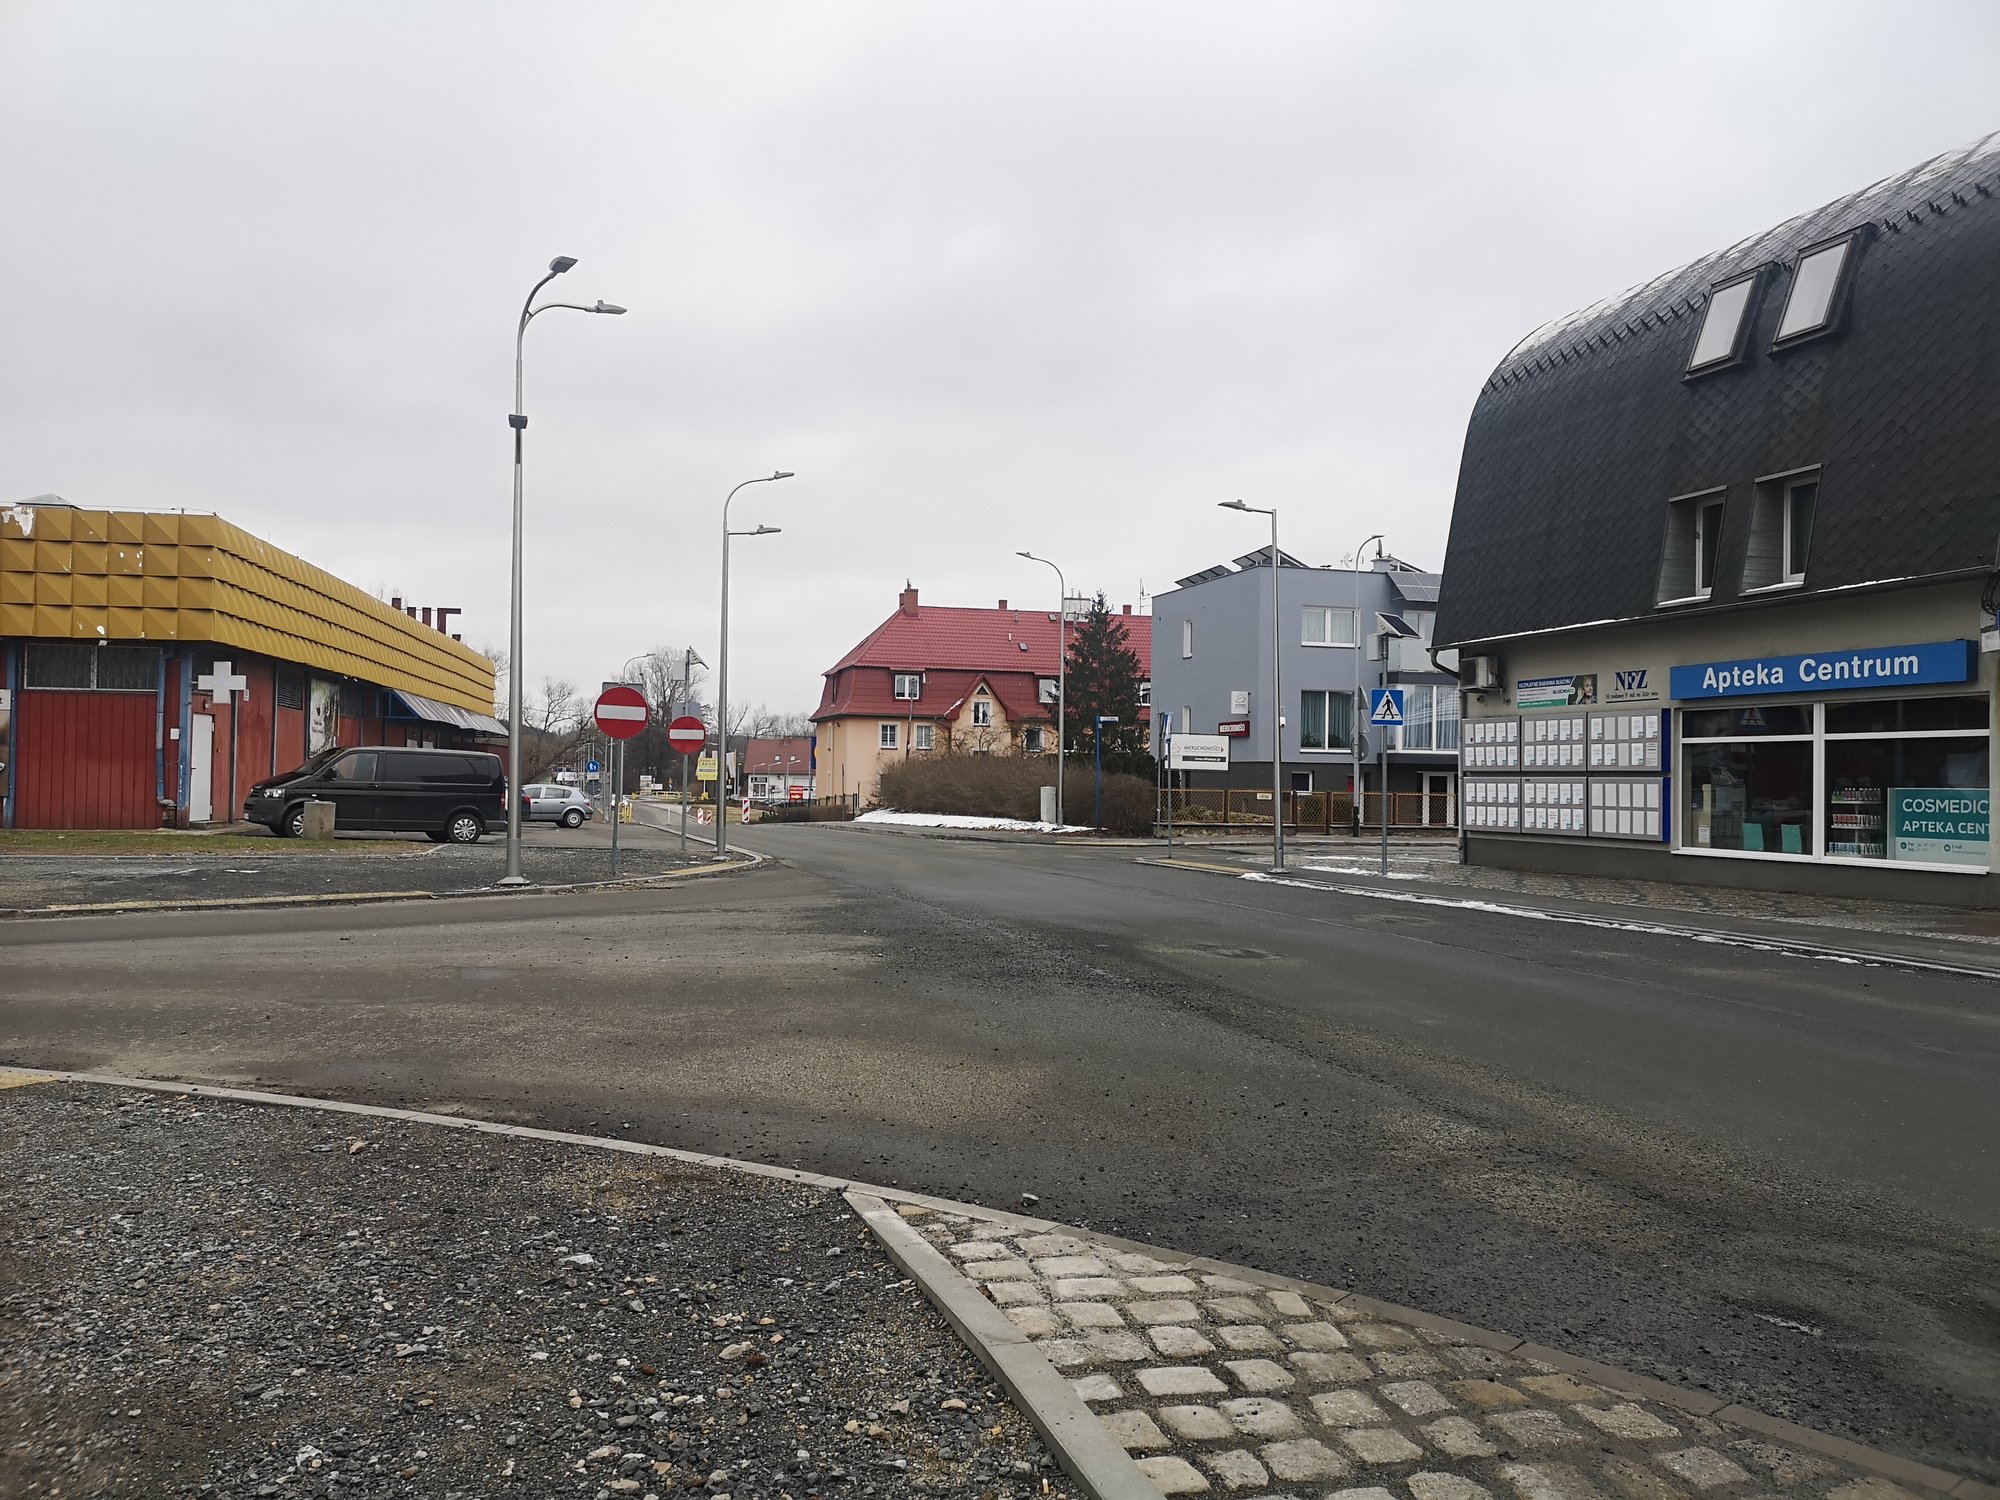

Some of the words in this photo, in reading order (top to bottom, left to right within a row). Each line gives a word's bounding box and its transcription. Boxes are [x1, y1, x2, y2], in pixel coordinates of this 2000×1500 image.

[1615, 669, 1648, 691] NFZ
[1702, 663, 1784, 693] Apteka
[1799, 655, 1919, 683] Centrum
[1902, 798, 1990, 814] COSMEDIC
[1902, 820, 1955, 833] APTEKA
